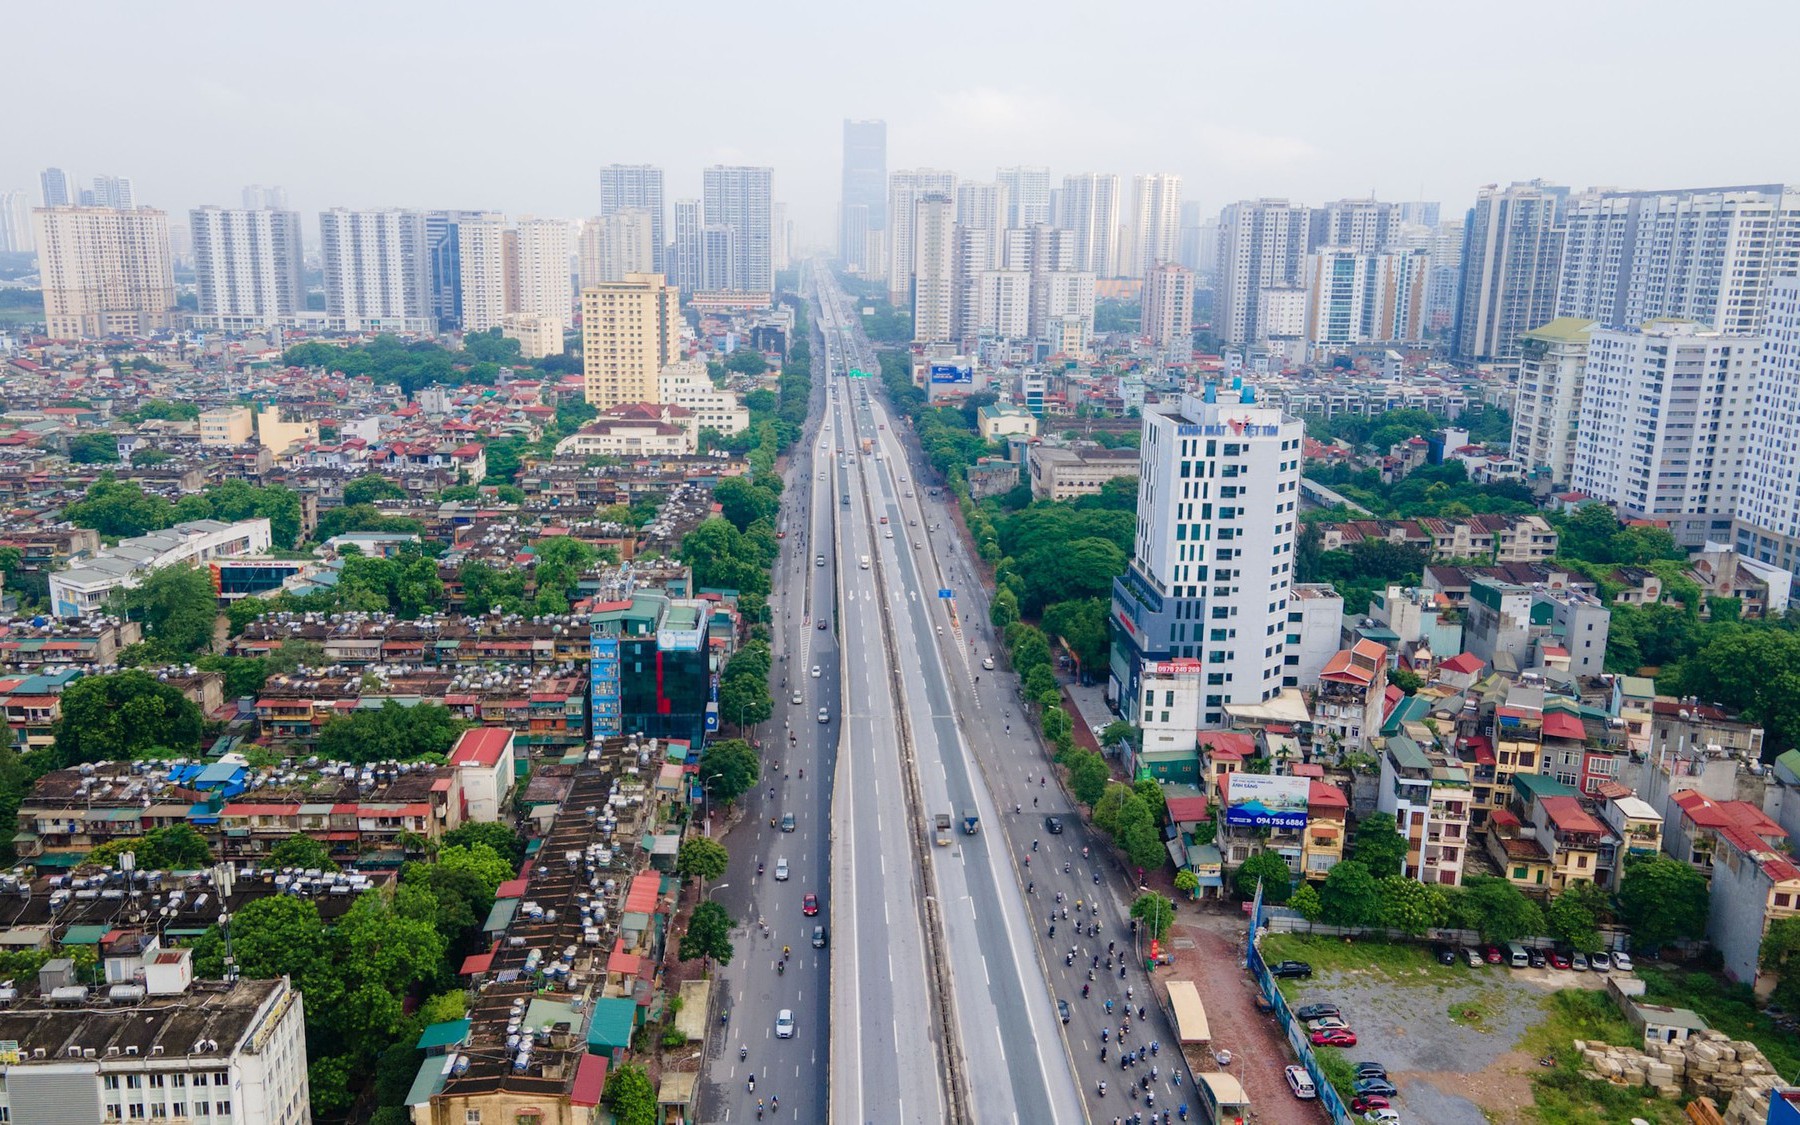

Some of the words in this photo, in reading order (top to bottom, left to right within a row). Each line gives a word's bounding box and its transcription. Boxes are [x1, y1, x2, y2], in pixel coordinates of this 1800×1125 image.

[1256, 817, 1271, 825] 094
[1271, 818, 1285, 826] 755
[1285, 818, 1304, 827] 6886
